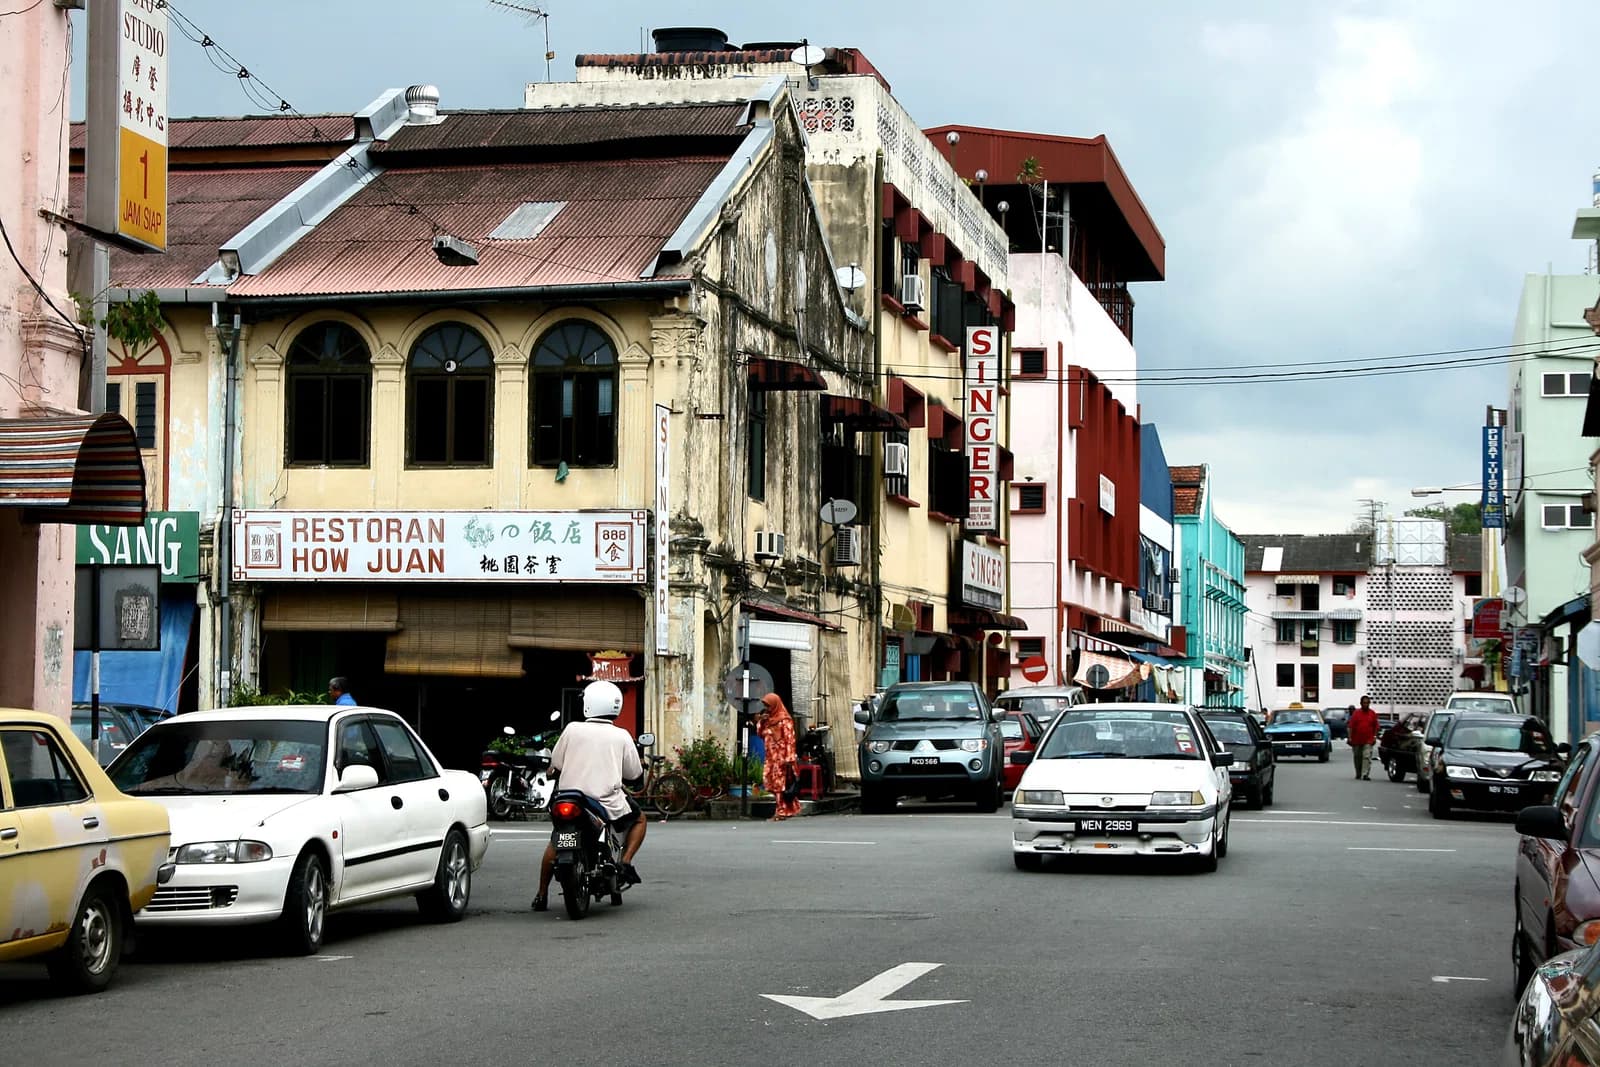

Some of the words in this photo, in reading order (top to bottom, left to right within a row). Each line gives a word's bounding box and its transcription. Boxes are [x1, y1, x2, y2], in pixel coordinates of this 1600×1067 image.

[124, 11, 164, 58] STUDIO
[131, 54, 158, 91] 摩登
[139, 149, 148, 200] 1
[123, 199, 141, 226] JAM
[143, 206, 162, 234] SIAP
[969, 330, 993, 499] SINGER
[1487, 428, 1498, 459] PUSAT
[292, 518, 445, 543] RESTORAN
[602, 529, 627, 541] 888
[90, 517, 182, 576] SANG
[292, 548, 349, 573] HOW
[367, 548, 445, 573] JUAN
[605, 542, 625, 562] 食
[479, 554, 562, 575] 桃園茶室
[970, 550, 1002, 589] SINGER
[1178, 741, 1192, 752] P
[1081, 820, 1102, 830] WEN
[1105, 820, 1133, 831] 2969
[557, 840, 577, 848] 2661
